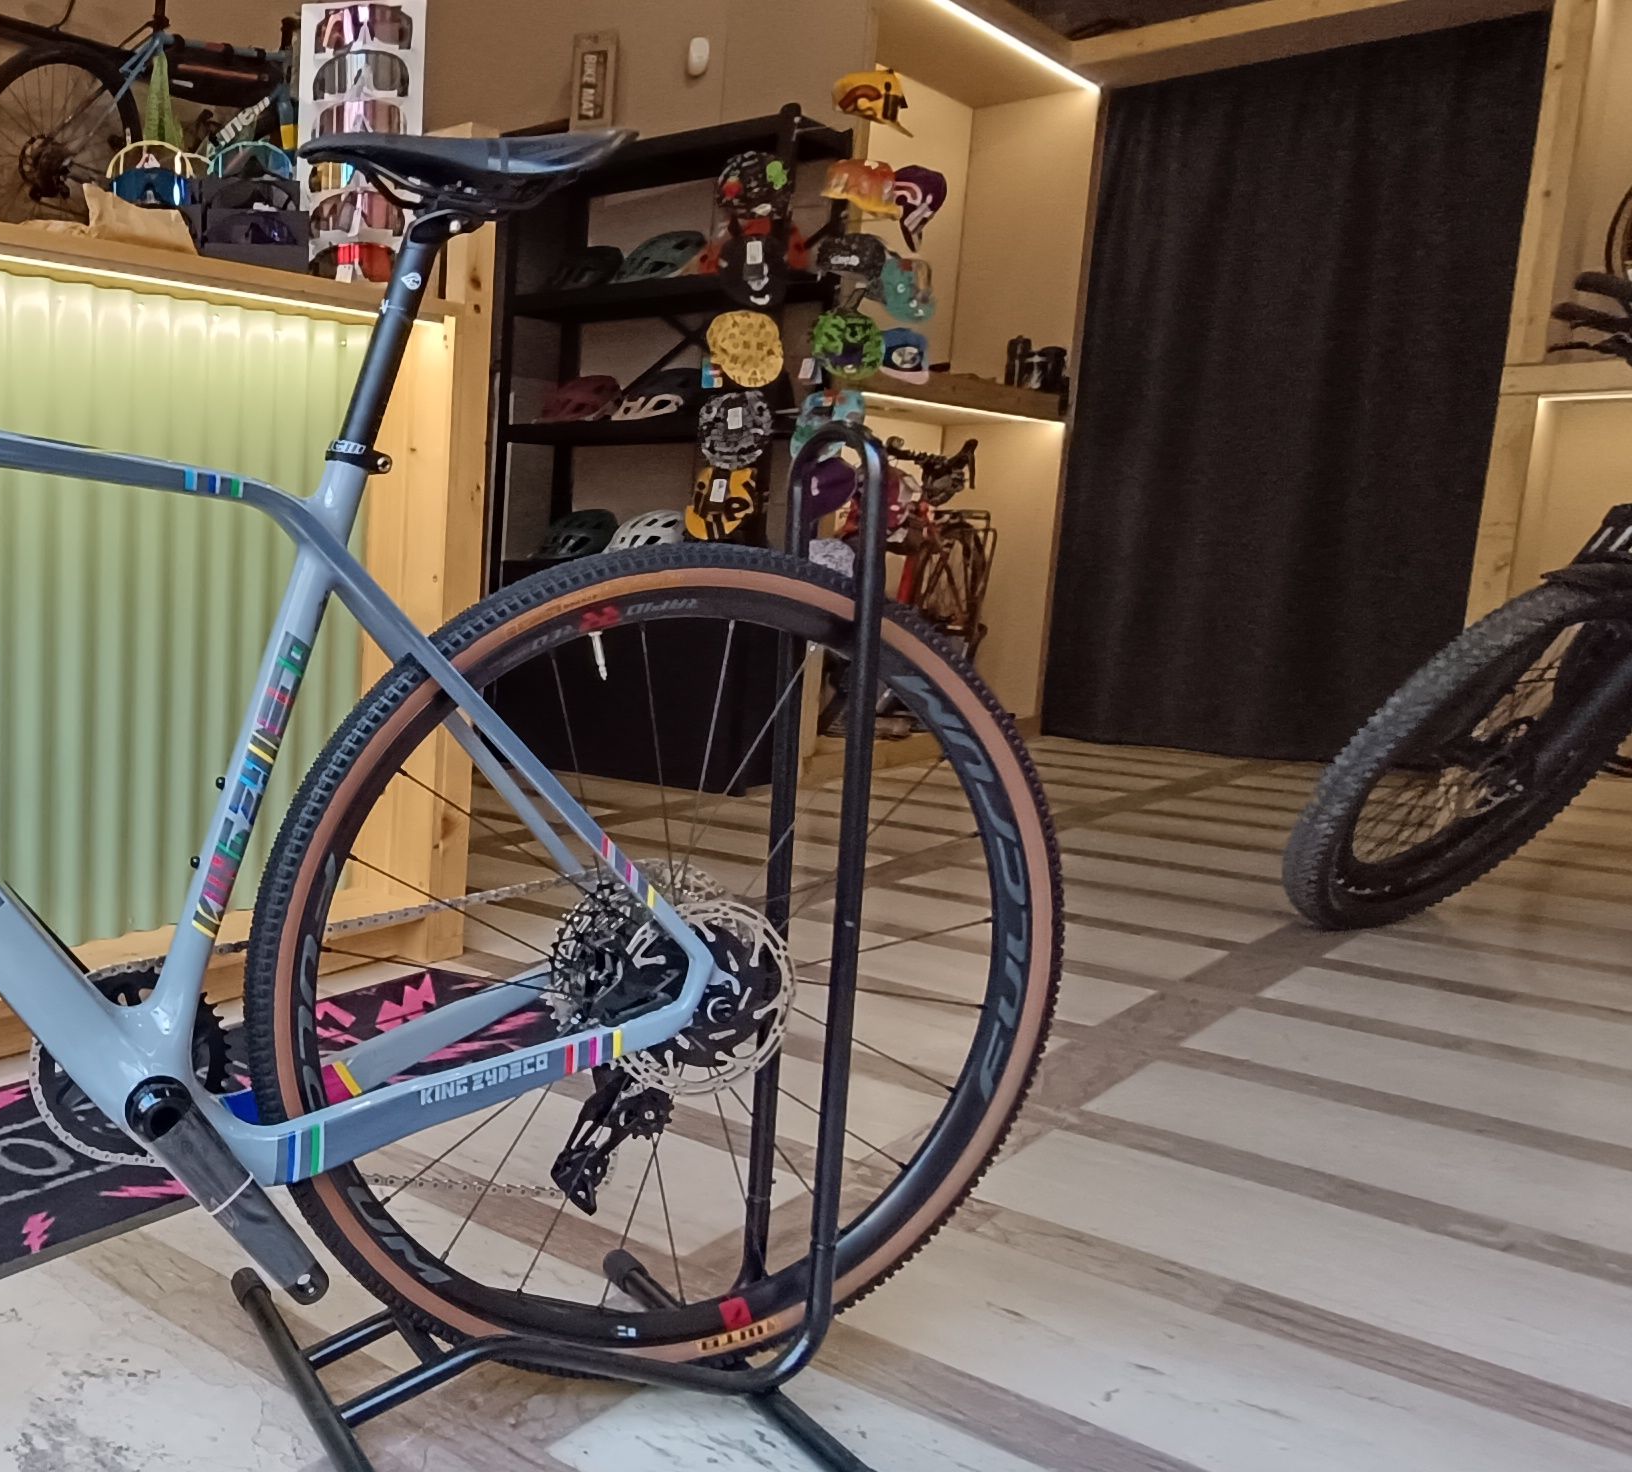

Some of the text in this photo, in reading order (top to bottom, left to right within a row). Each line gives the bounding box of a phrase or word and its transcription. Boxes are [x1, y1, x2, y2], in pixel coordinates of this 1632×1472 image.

[579, 53, 598, 118] BIKE MAT
[889, 673, 1033, 1101] FULCRUM
[420, 1053, 550, 1106] KING ZYDECO
